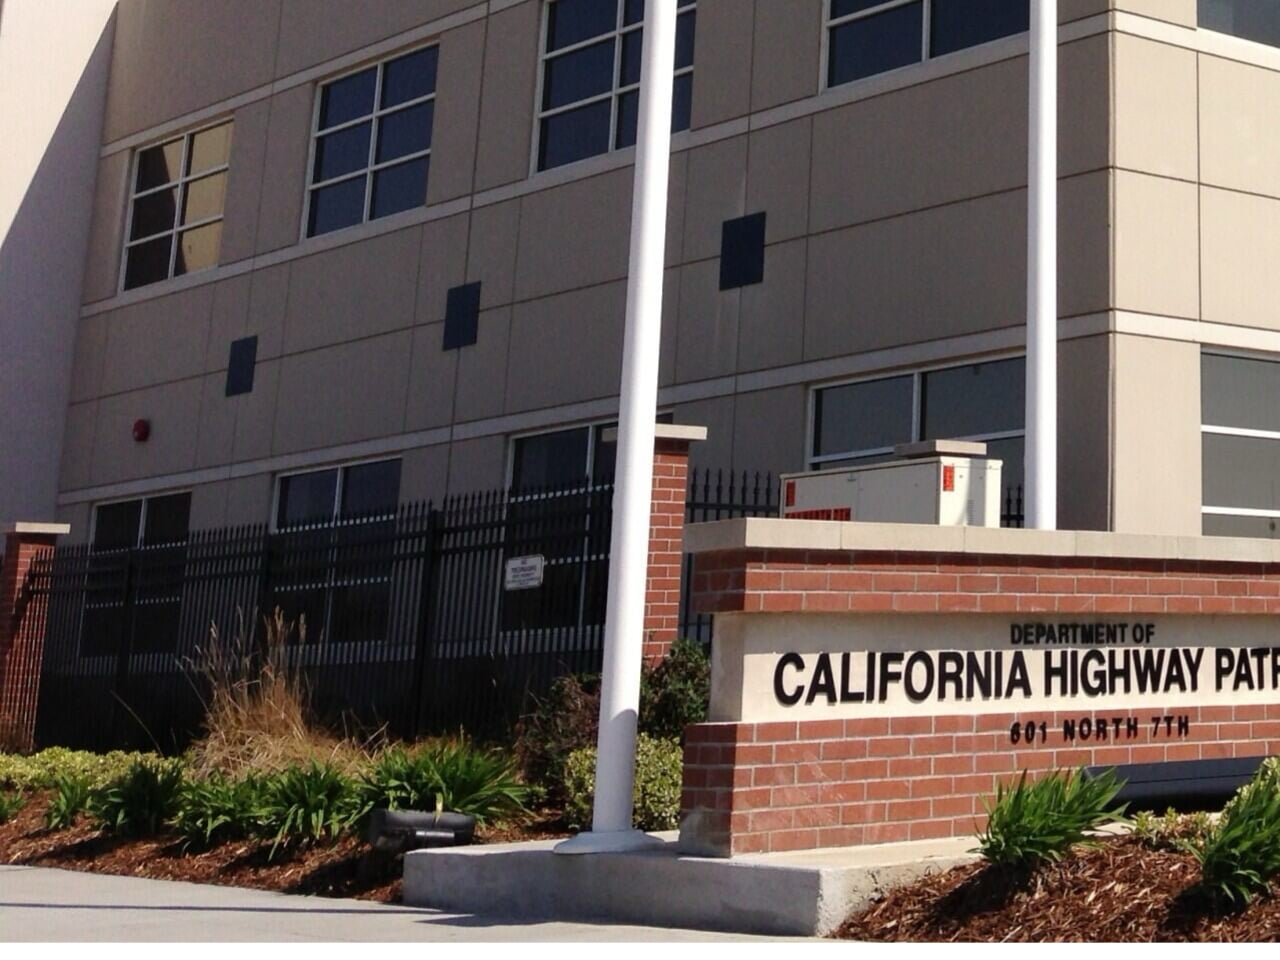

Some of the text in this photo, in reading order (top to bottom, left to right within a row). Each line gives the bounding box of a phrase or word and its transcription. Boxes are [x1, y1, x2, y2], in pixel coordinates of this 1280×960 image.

[1010, 623, 1155, 645] DEPARTMENT OF
[773, 651, 1032, 705] CALIFORNIA
[1044, 647, 1205, 696] HIGHWAY
[1010, 715, 1190, 745] 601 NORTH 7TH
